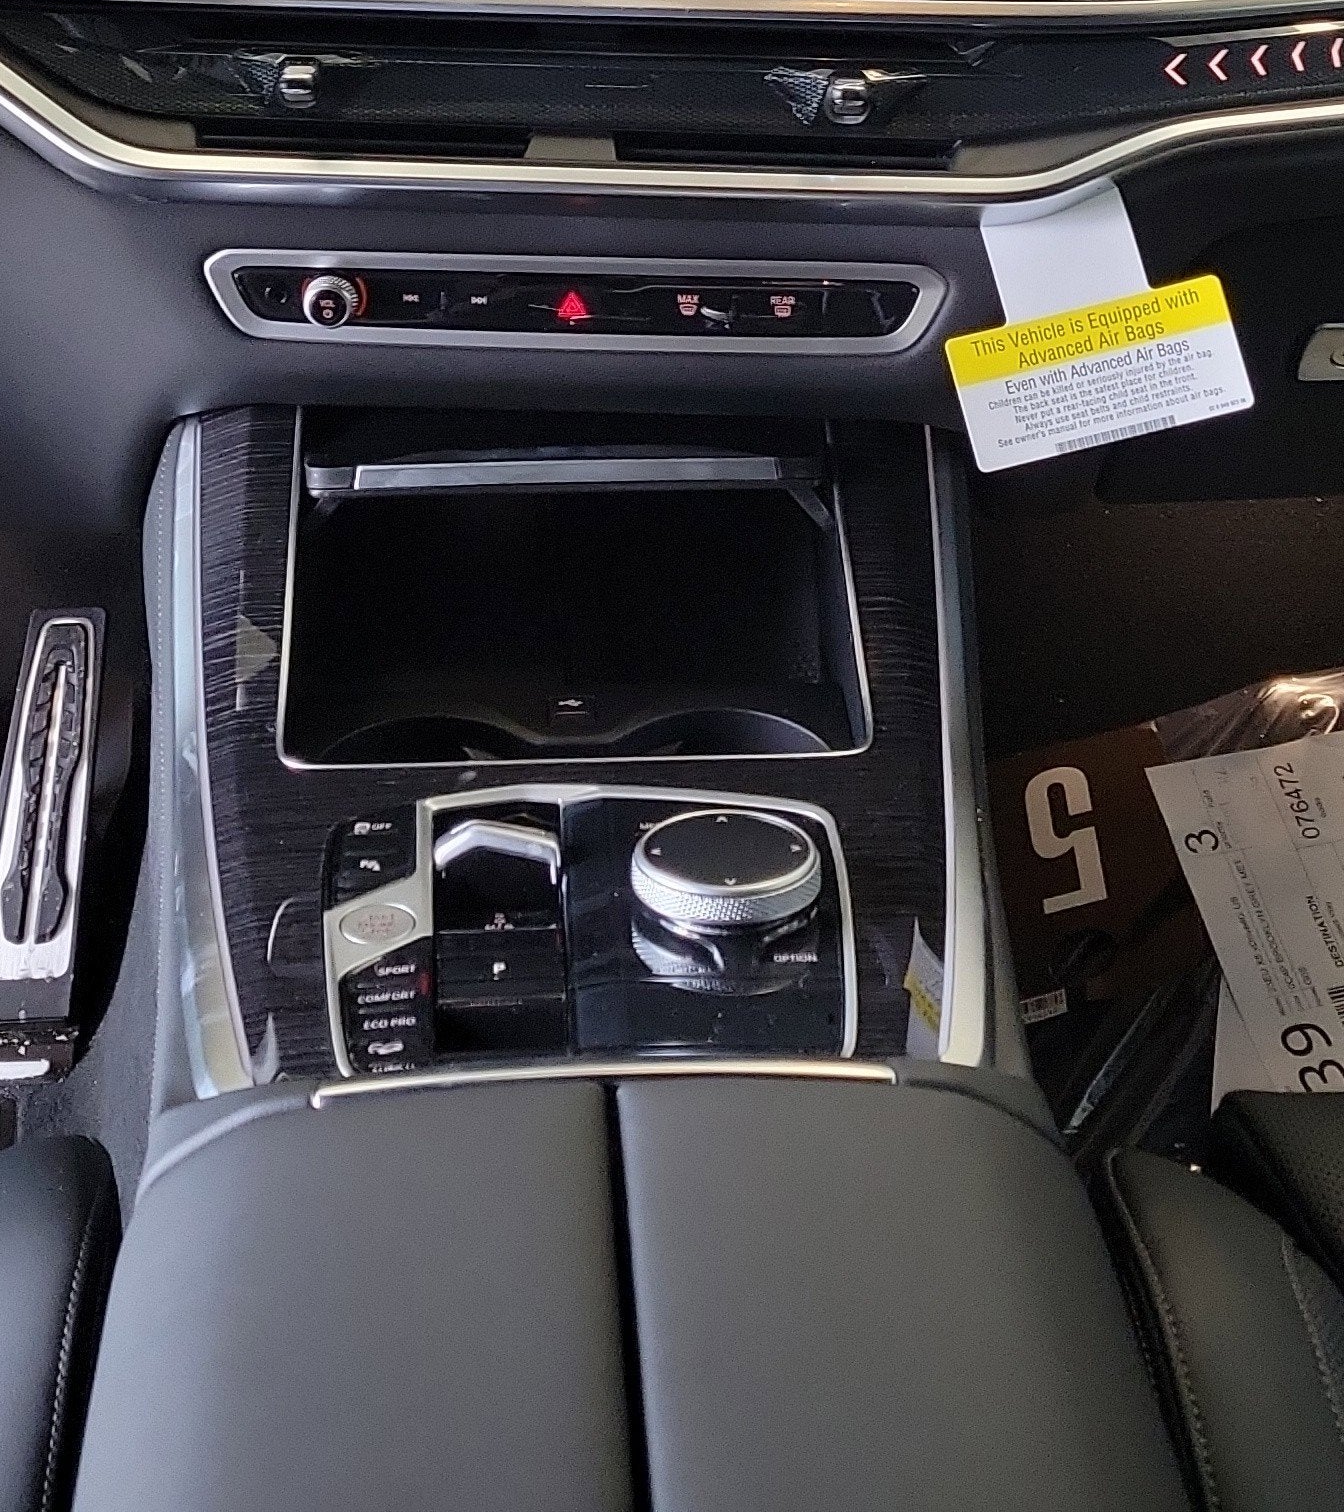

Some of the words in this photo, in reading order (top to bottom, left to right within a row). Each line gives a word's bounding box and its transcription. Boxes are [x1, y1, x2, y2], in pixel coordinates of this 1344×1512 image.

[677, 293, 700, 304] MAX
[770, 295, 796, 305] REAR
[971, 338, 1005, 356] This
[1008, 323, 1065, 347] Vehicle
[1069, 318, 1084, 334] is
[1087, 299, 1161, 327] Equipped
[1165, 289, 1199, 309] with
[1006, 378, 1037, 394] Even
[1040, 369, 1067, 386] with
[1072, 352, 1132, 378] Advanced
[1137, 347, 1153, 363] Air
[1157, 341, 1189, 357] Bags
[1020, 336, 1093, 368] Advanced
[1100, 330, 1119, 349] Air
[1125, 322, 1164, 341] Bags
[989, 397, 1022, 410] Children
[1024, 393, 1038, 402] can
[1040, 390, 1050, 398] be
[1052, 383, 1074, 394] killed
[1076, 381, 1084, 389] or
[1087, 372, 1123, 386] seriously
[1126, 364, 1154, 376] injured
[1156, 362, 1165, 370] by
[1168, 354, 1181, 366] the
[1183, 353, 1193, 362] air
[1196, 350, 1212, 358] bag
[1013, 405, 1028, 414] The
[1030, 399, 1049, 410] back
[1052, 394, 1068, 405] seat
[1079, 390, 1092, 398] the
[1095, 382, 1119, 394] safest
[1121, 378, 1142, 389] place
[1144, 374, 1156, 382] for
[1159, 365, 1194, 378] children.
[1015, 413, 1037, 423] Never
[1040, 408, 1054, 419] put
[1064, 396, 1106, 412] rear-facing
[1109, 388, 1128, 400] child
[1131, 385, 1148, 395] seat
[1160, 380, 1173, 388] the
[1175, 373, 1197, 384] front.
[998, 439, 1013, 448] See
[1015, 430, 1046, 444] owner's
[1047, 422, 1077, 436] manual
[1079, 420, 1090, 428] for
[1093, 414, 1114, 424] more
[1117, 402, 1163, 418] information
[1166, 395, 1188, 406] about
[1191, 392, 1200, 400] air
[1204, 387, 1223, 397] bags.
[1026, 418, 1053, 431] Always
[1055, 415, 1069, 424] use
[1072, 410, 1088, 420] seat
[1090, 403, 1110, 415] belts
[1113, 400, 1127, 410] and
[1130, 394, 1149, 405] child
[1152, 386, 1190, 400] restraints.
[1274, 764, 1320, 839] 076472
[1024, 766, 1108, 914] 5
[1185, 830, 1219, 853] 3
[1307, 896, 1344, 967] DESTINATION
[773, 952, 818, 963] OPTION
[357, 990, 416, 1004] COMFORT
